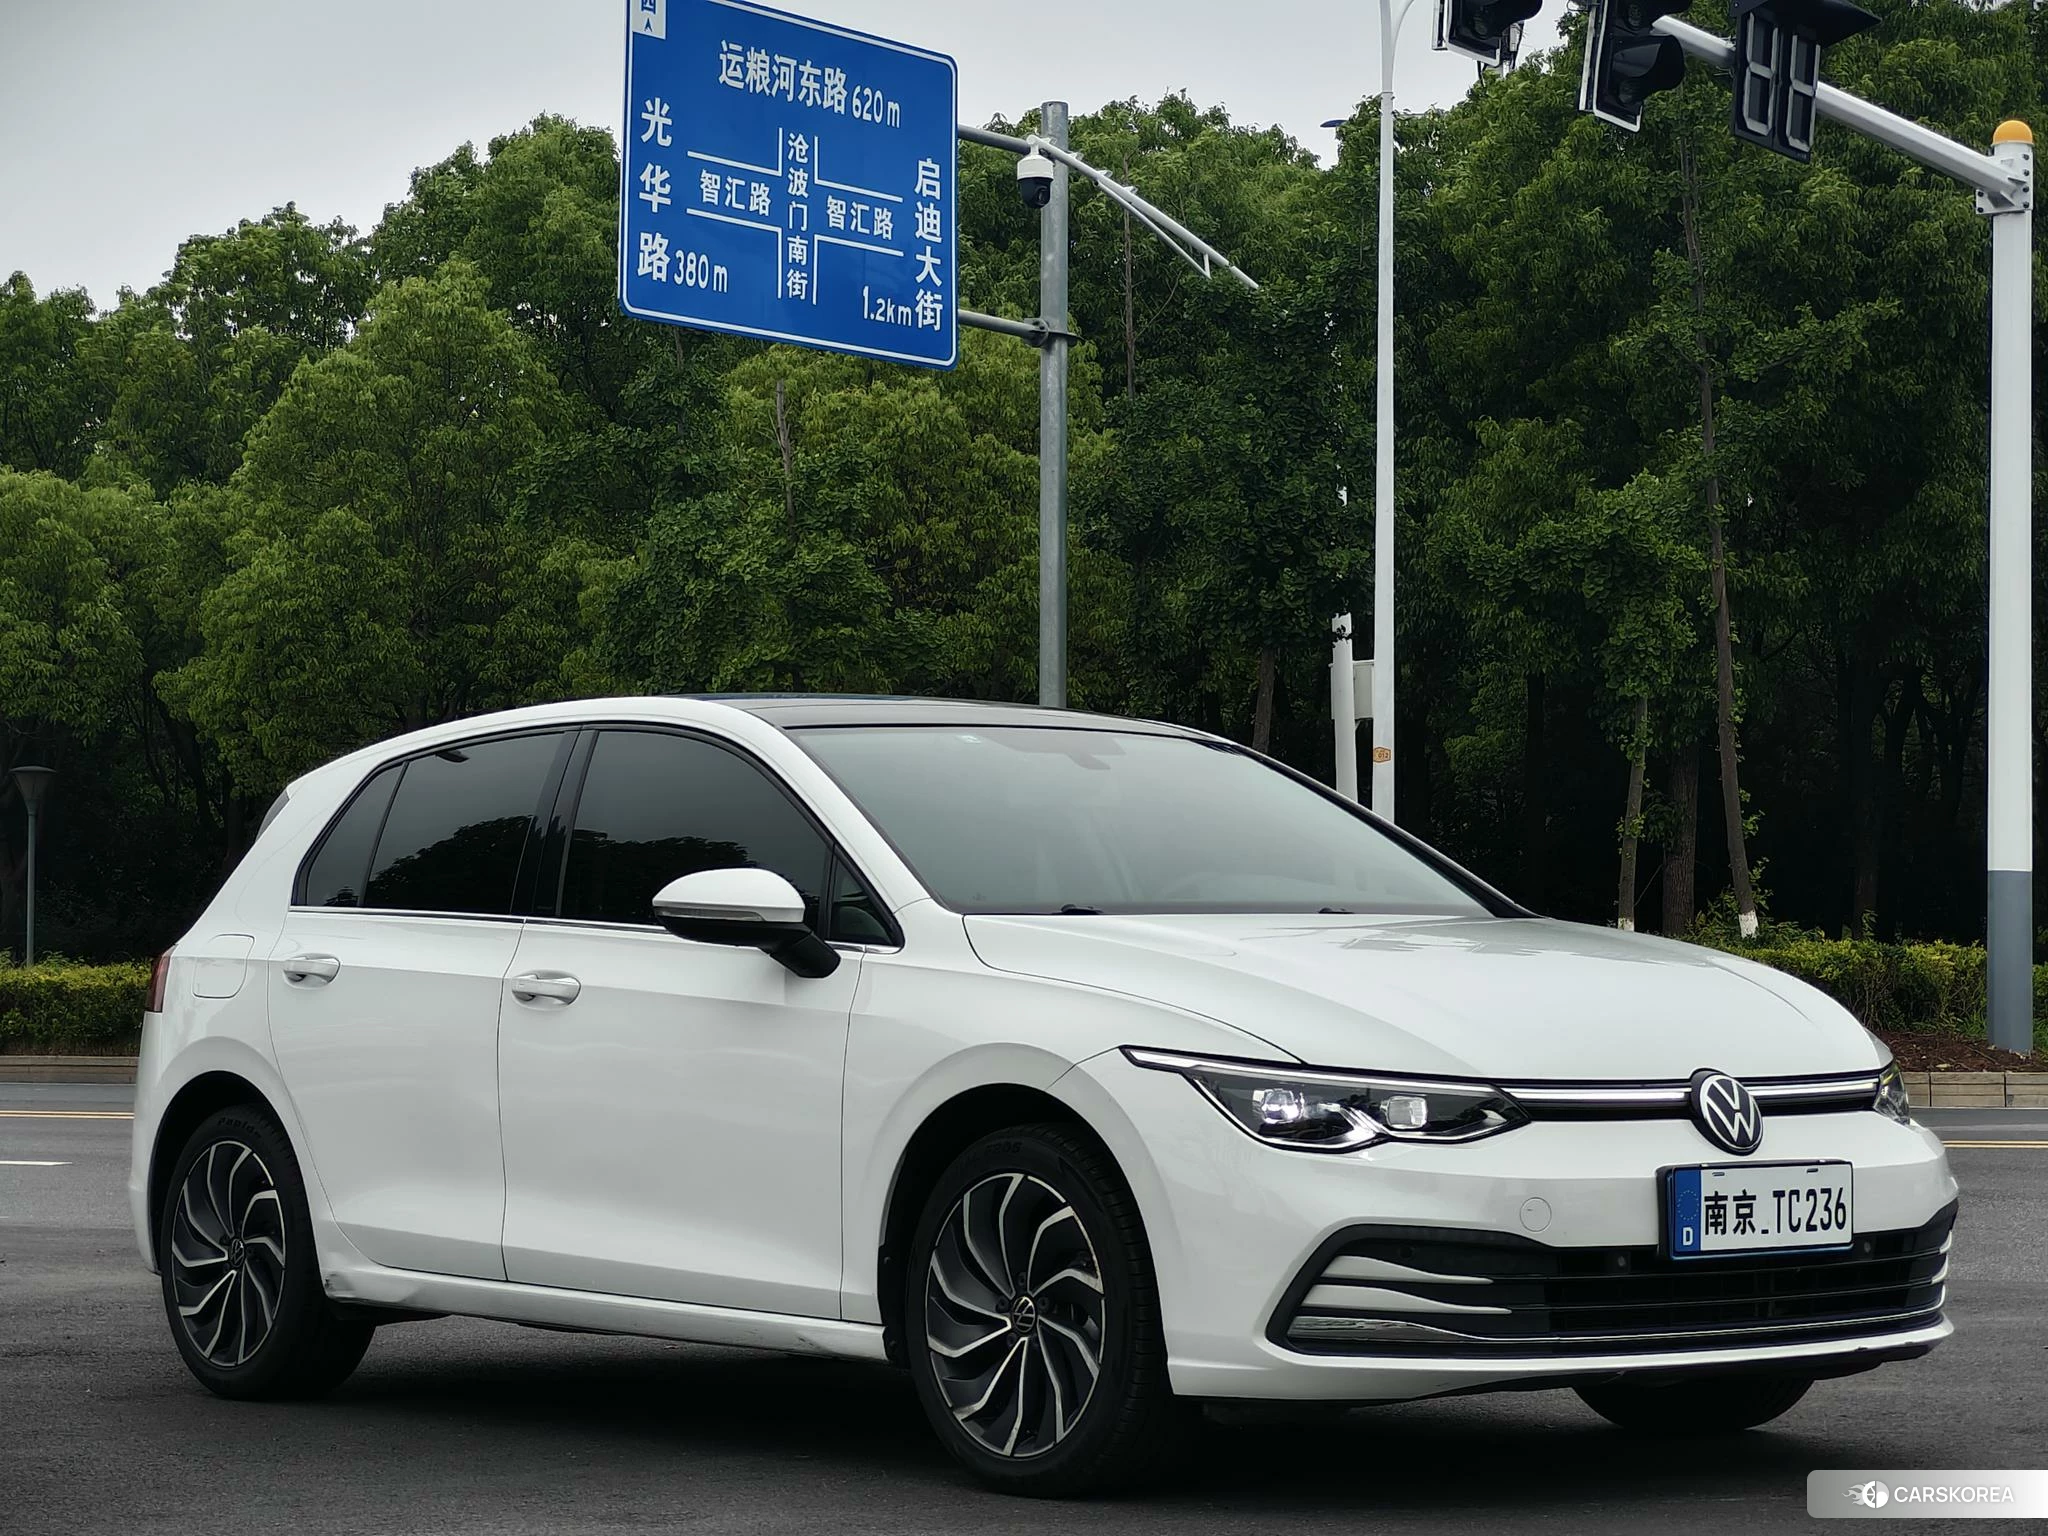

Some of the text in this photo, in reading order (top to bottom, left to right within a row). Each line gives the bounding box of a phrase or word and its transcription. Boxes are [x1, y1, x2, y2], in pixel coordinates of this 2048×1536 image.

[719, 40, 901, 129] 运粮河东路 620m
[637, 97, 673, 283] 光华路
[699, 169, 772, 217] 智汇路
[787, 132, 810, 301] 沧波门南街
[826, 195, 894, 241] 智汇路
[914, 158, 944, 332] 启迪大街
[673, 250, 728, 293] 380m
[862, 286, 912, 327] 1.2km
[1682, 1227, 1694, 1246] D
